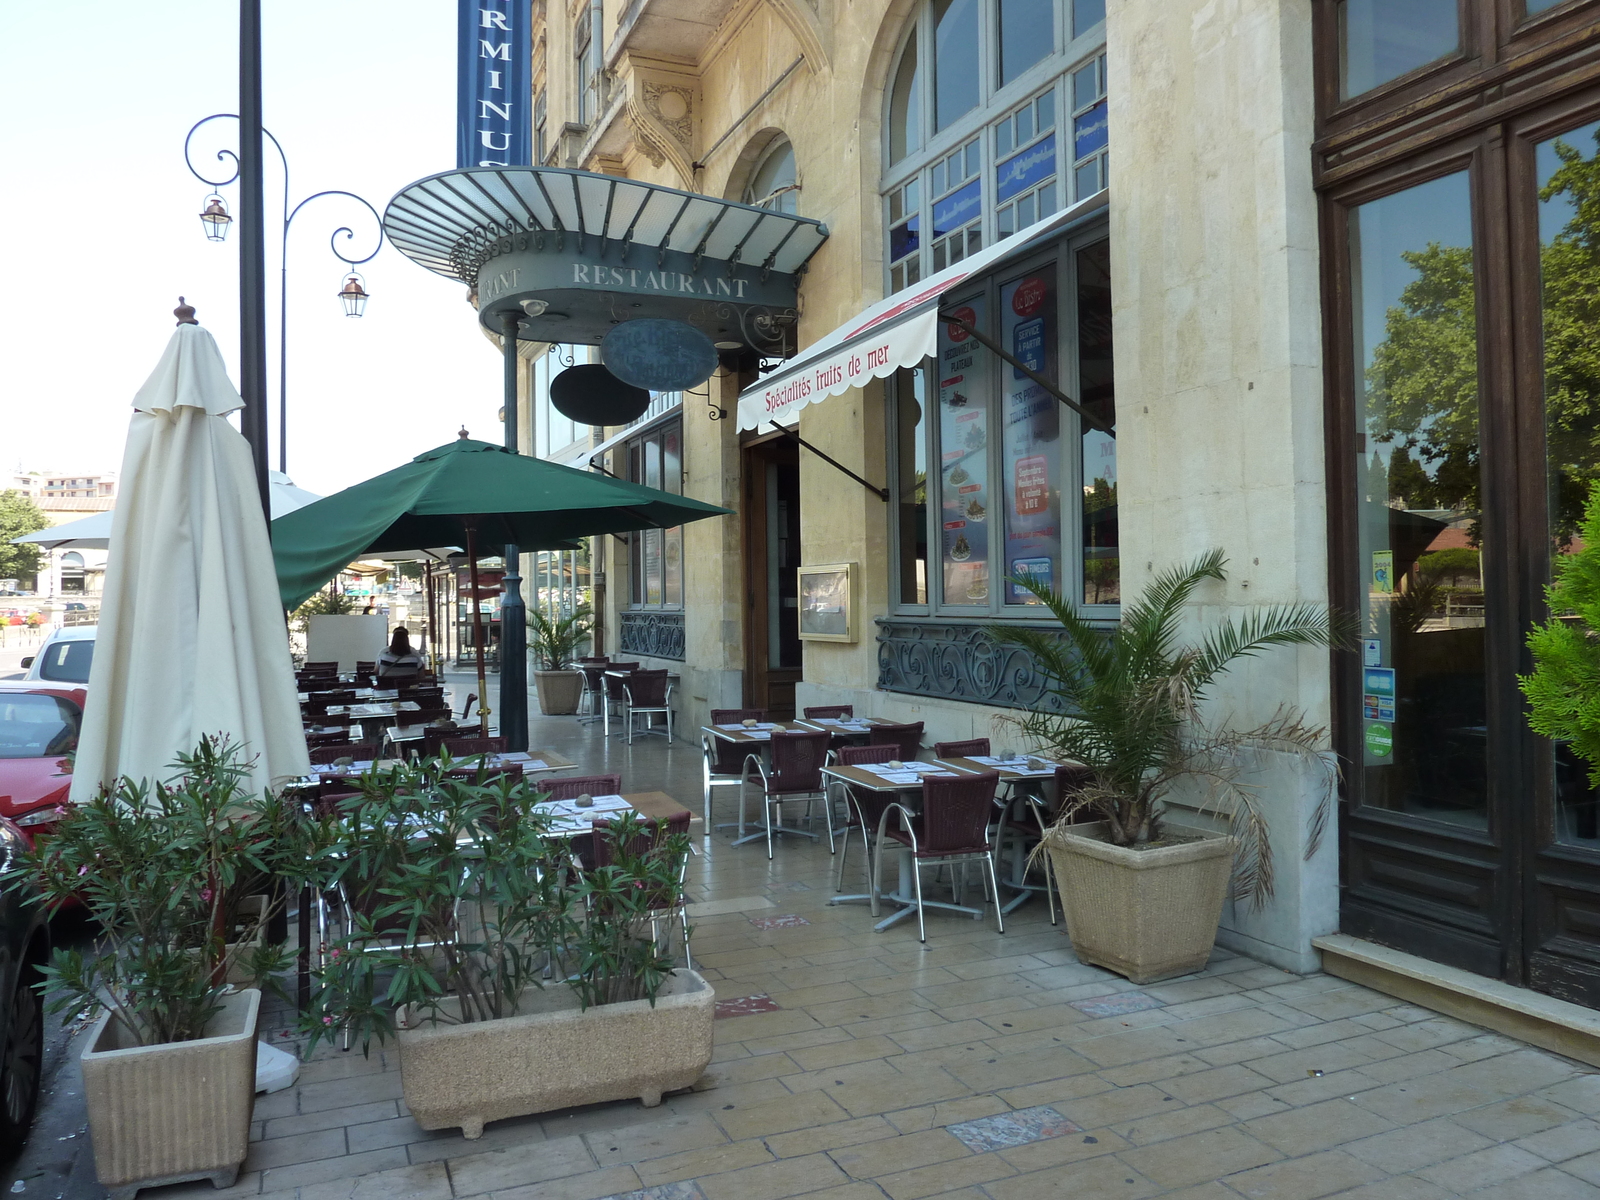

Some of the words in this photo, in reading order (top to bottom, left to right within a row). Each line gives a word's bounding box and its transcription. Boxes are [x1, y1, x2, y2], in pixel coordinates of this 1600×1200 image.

[572, 263, 749, 298] RESTAURANT
[1018, 325, 1040, 341] SERVICE
[1022, 337, 1041, 350] PARTIR
[950, 356, 973, 373] PLATEAUX
[765, 376, 811, 413] Spécialités
[816, 365, 842, 391] fruits
[848, 354, 861, 377] de
[867, 344, 889, 370] mer
